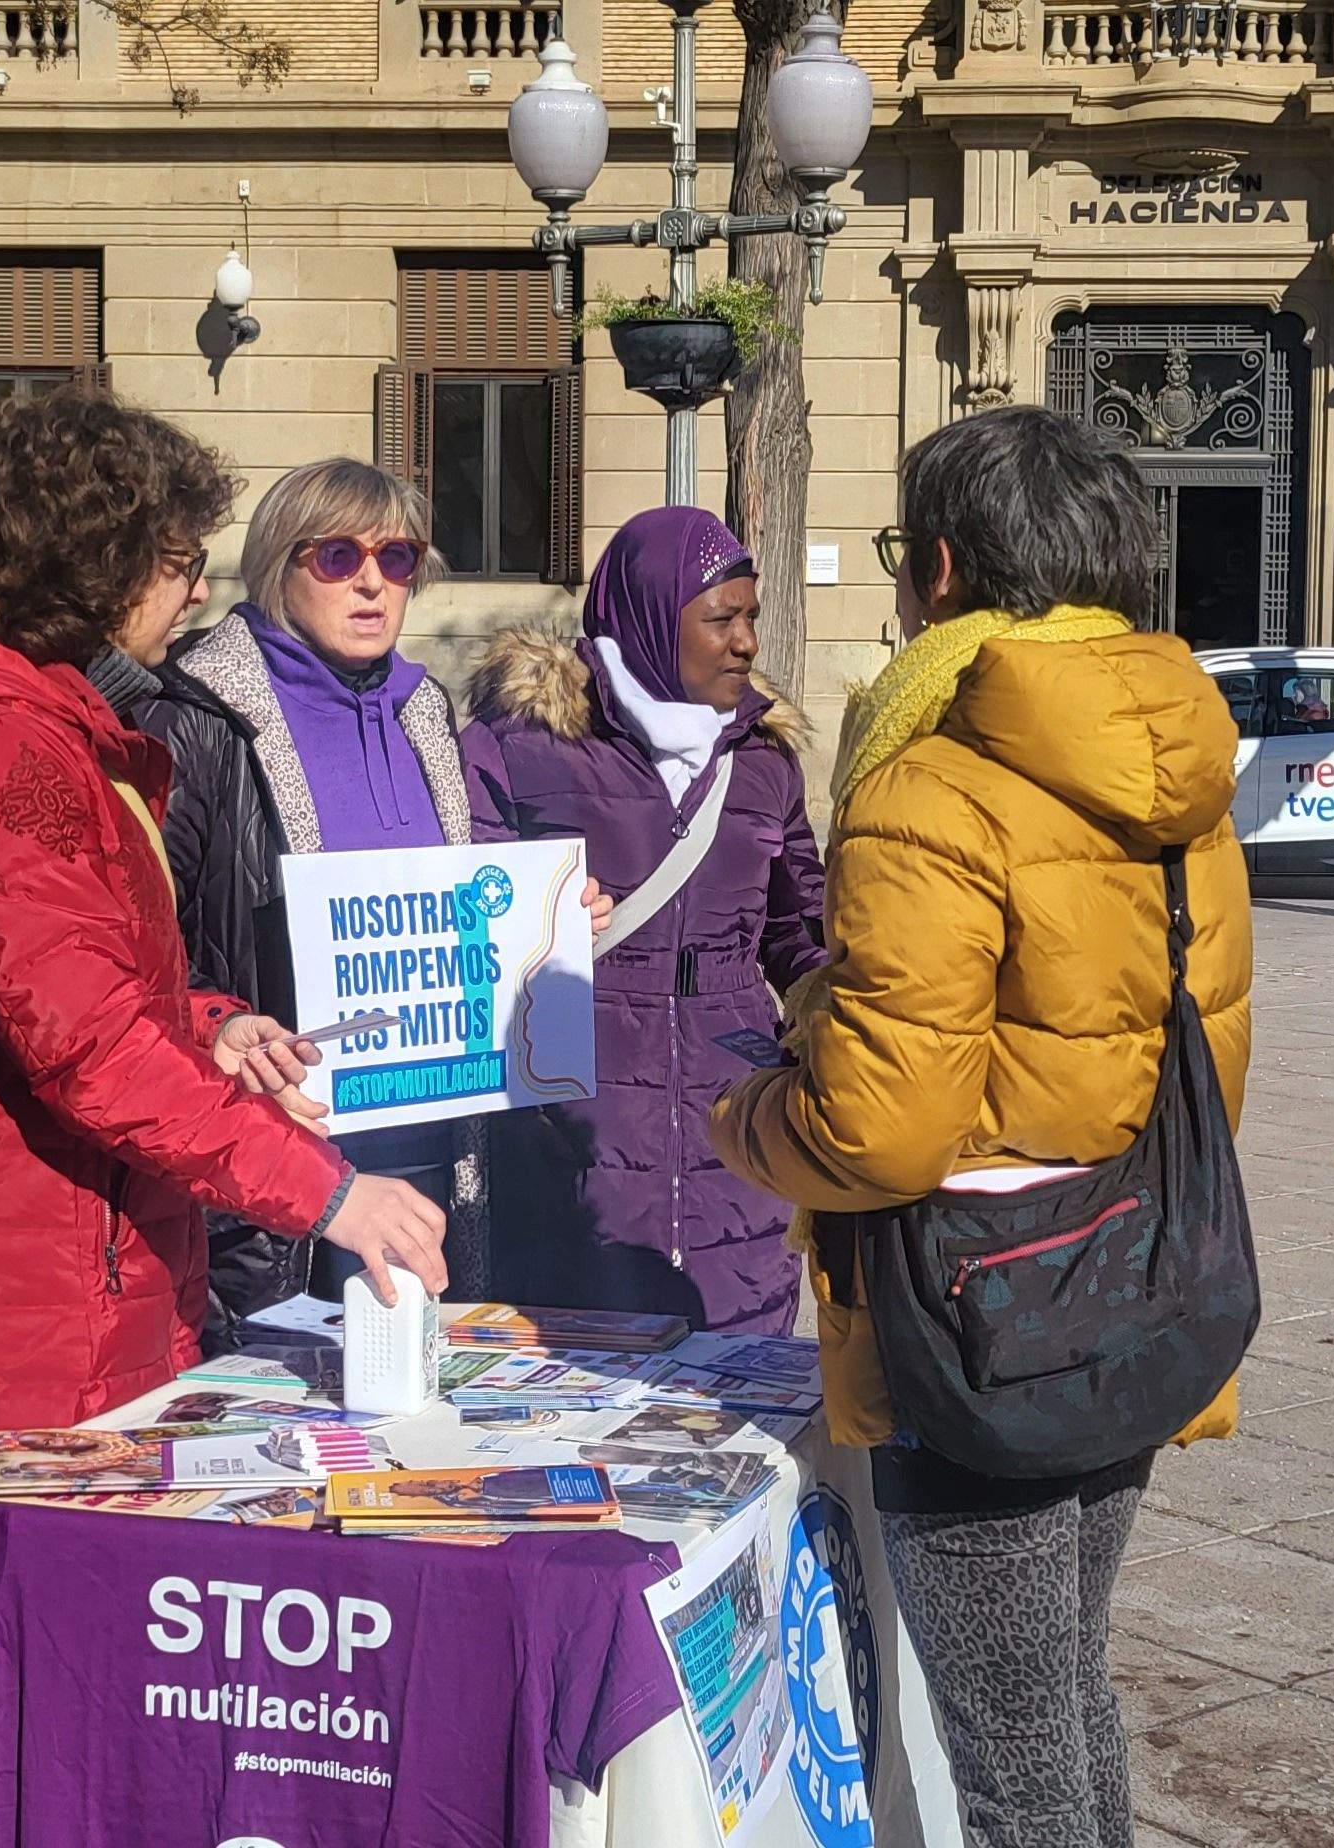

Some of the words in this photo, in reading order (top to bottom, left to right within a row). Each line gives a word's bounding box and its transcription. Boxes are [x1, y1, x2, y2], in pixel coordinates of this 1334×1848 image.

[1070, 201, 1290, 224] HACIENDA
[1286, 762, 1334, 787] rne
[1286, 792, 1334, 821] tve
[328, 889, 477, 941] NOSOTRAS
[334, 942, 501, 998] ROMPEMOS
[339, 1007, 388, 1054] LOS
[398, 997, 489, 1048] MITOS
[337, 1056, 501, 1107] #STOPMUTILACIÓN
[147, 1576, 392, 1673] STOP
[145, 1682, 390, 1743] mutilación
[234, 1752, 392, 1789] #stopmutilación
[796, 1723, 832, 1822] DEL
